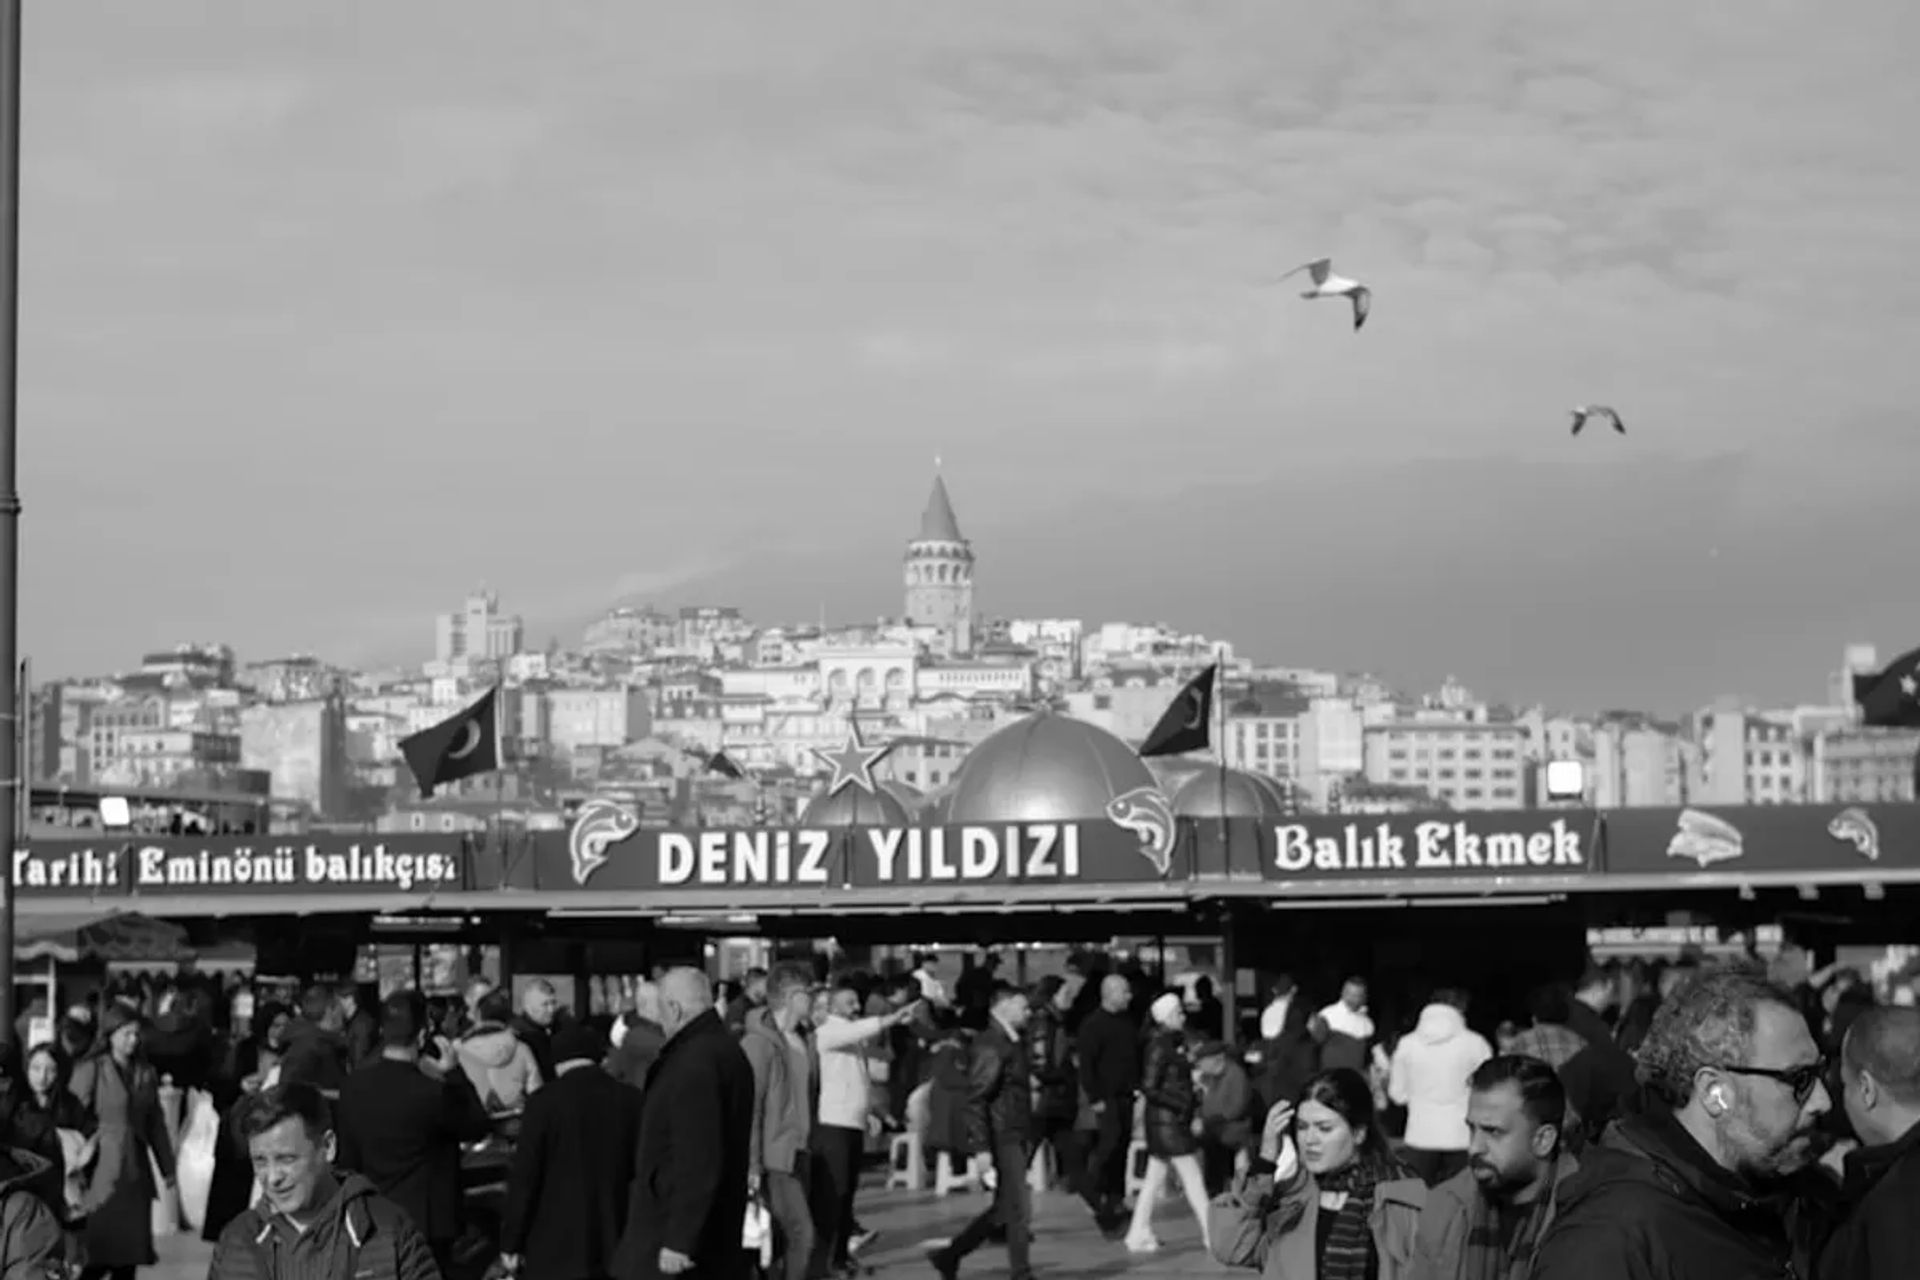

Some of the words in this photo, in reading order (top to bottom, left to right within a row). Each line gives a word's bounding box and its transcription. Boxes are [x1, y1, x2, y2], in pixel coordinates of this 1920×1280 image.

[139, 846, 295, 884] Eminönü
[868, 823, 1079, 881] YILDIZI
[1275, 823, 1406, 870] Balık
[1414, 818, 1583, 868] Ekmek
